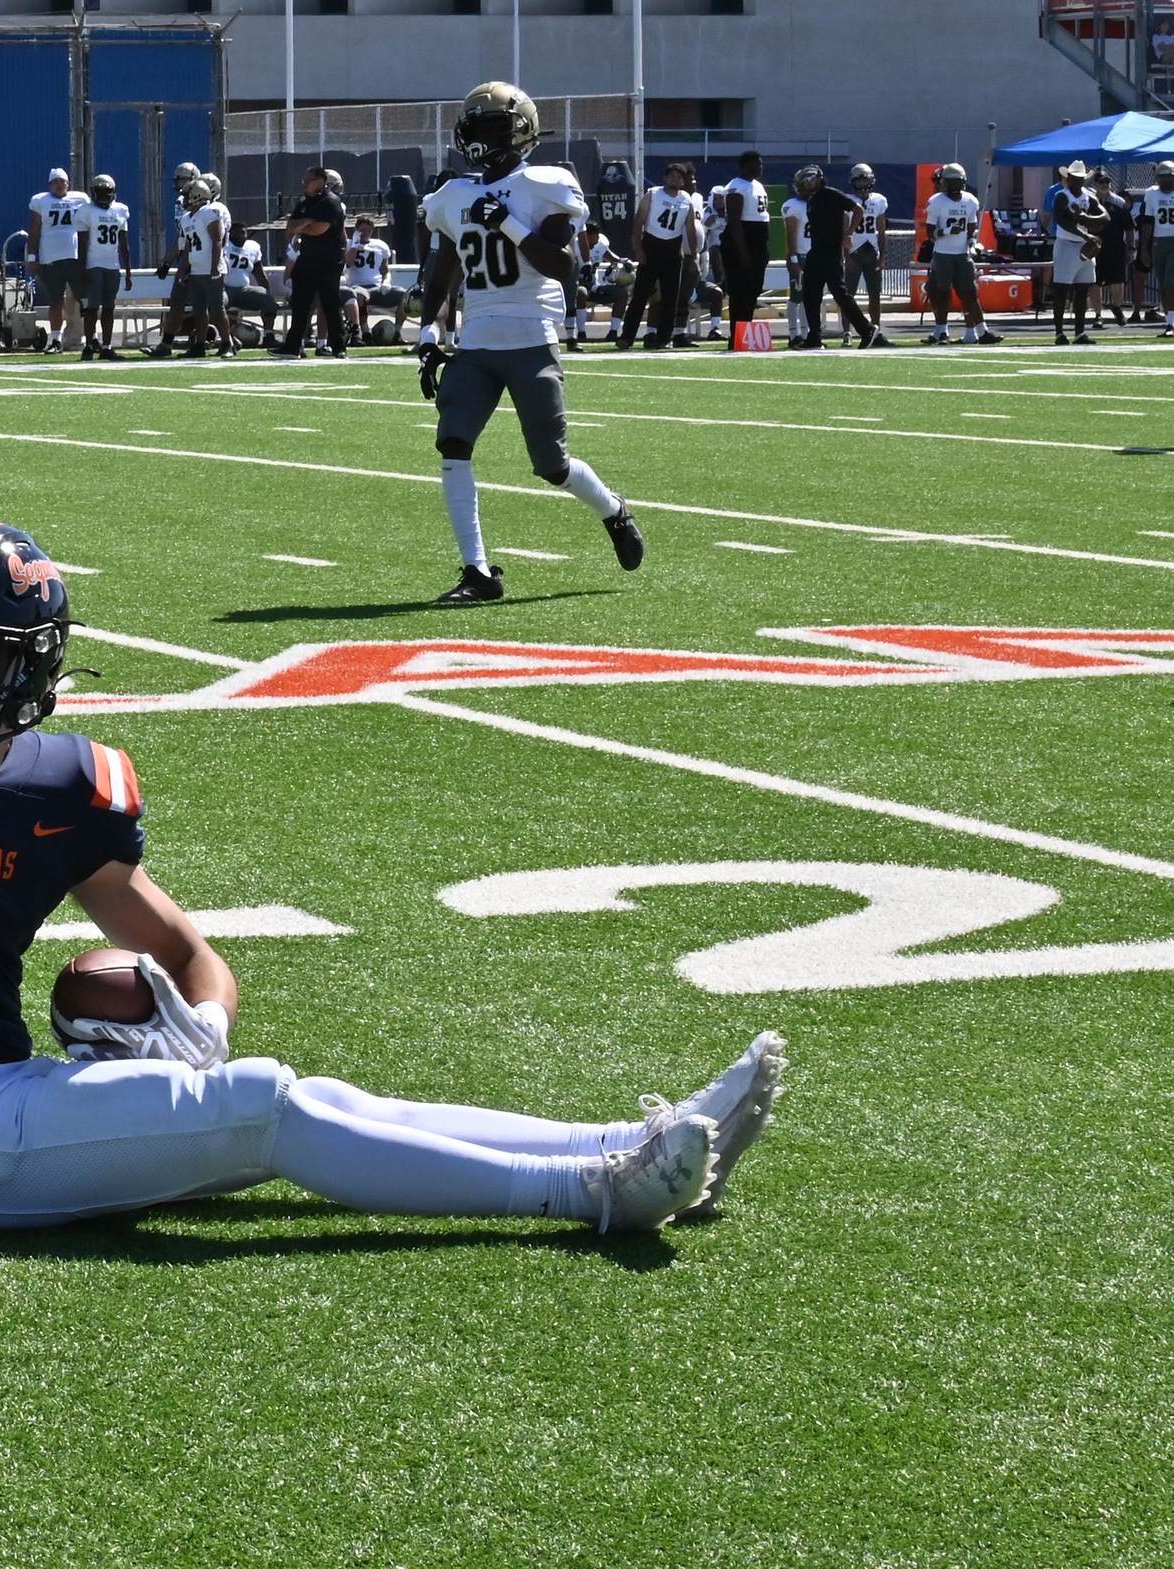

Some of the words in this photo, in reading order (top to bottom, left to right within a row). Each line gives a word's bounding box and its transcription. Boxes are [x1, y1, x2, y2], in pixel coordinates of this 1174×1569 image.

[49, 210, 72, 227] 74
[602, 201, 627, 220] 64
[657, 209, 679, 231] 41
[97, 225, 119, 245] 36
[355, 250, 376, 269] 54
[459, 231, 520, 290] 20
[1008, 284, 1019, 298] G
[742, 322, 771, 350] 40
[438, 862, 1174, 996] 2
